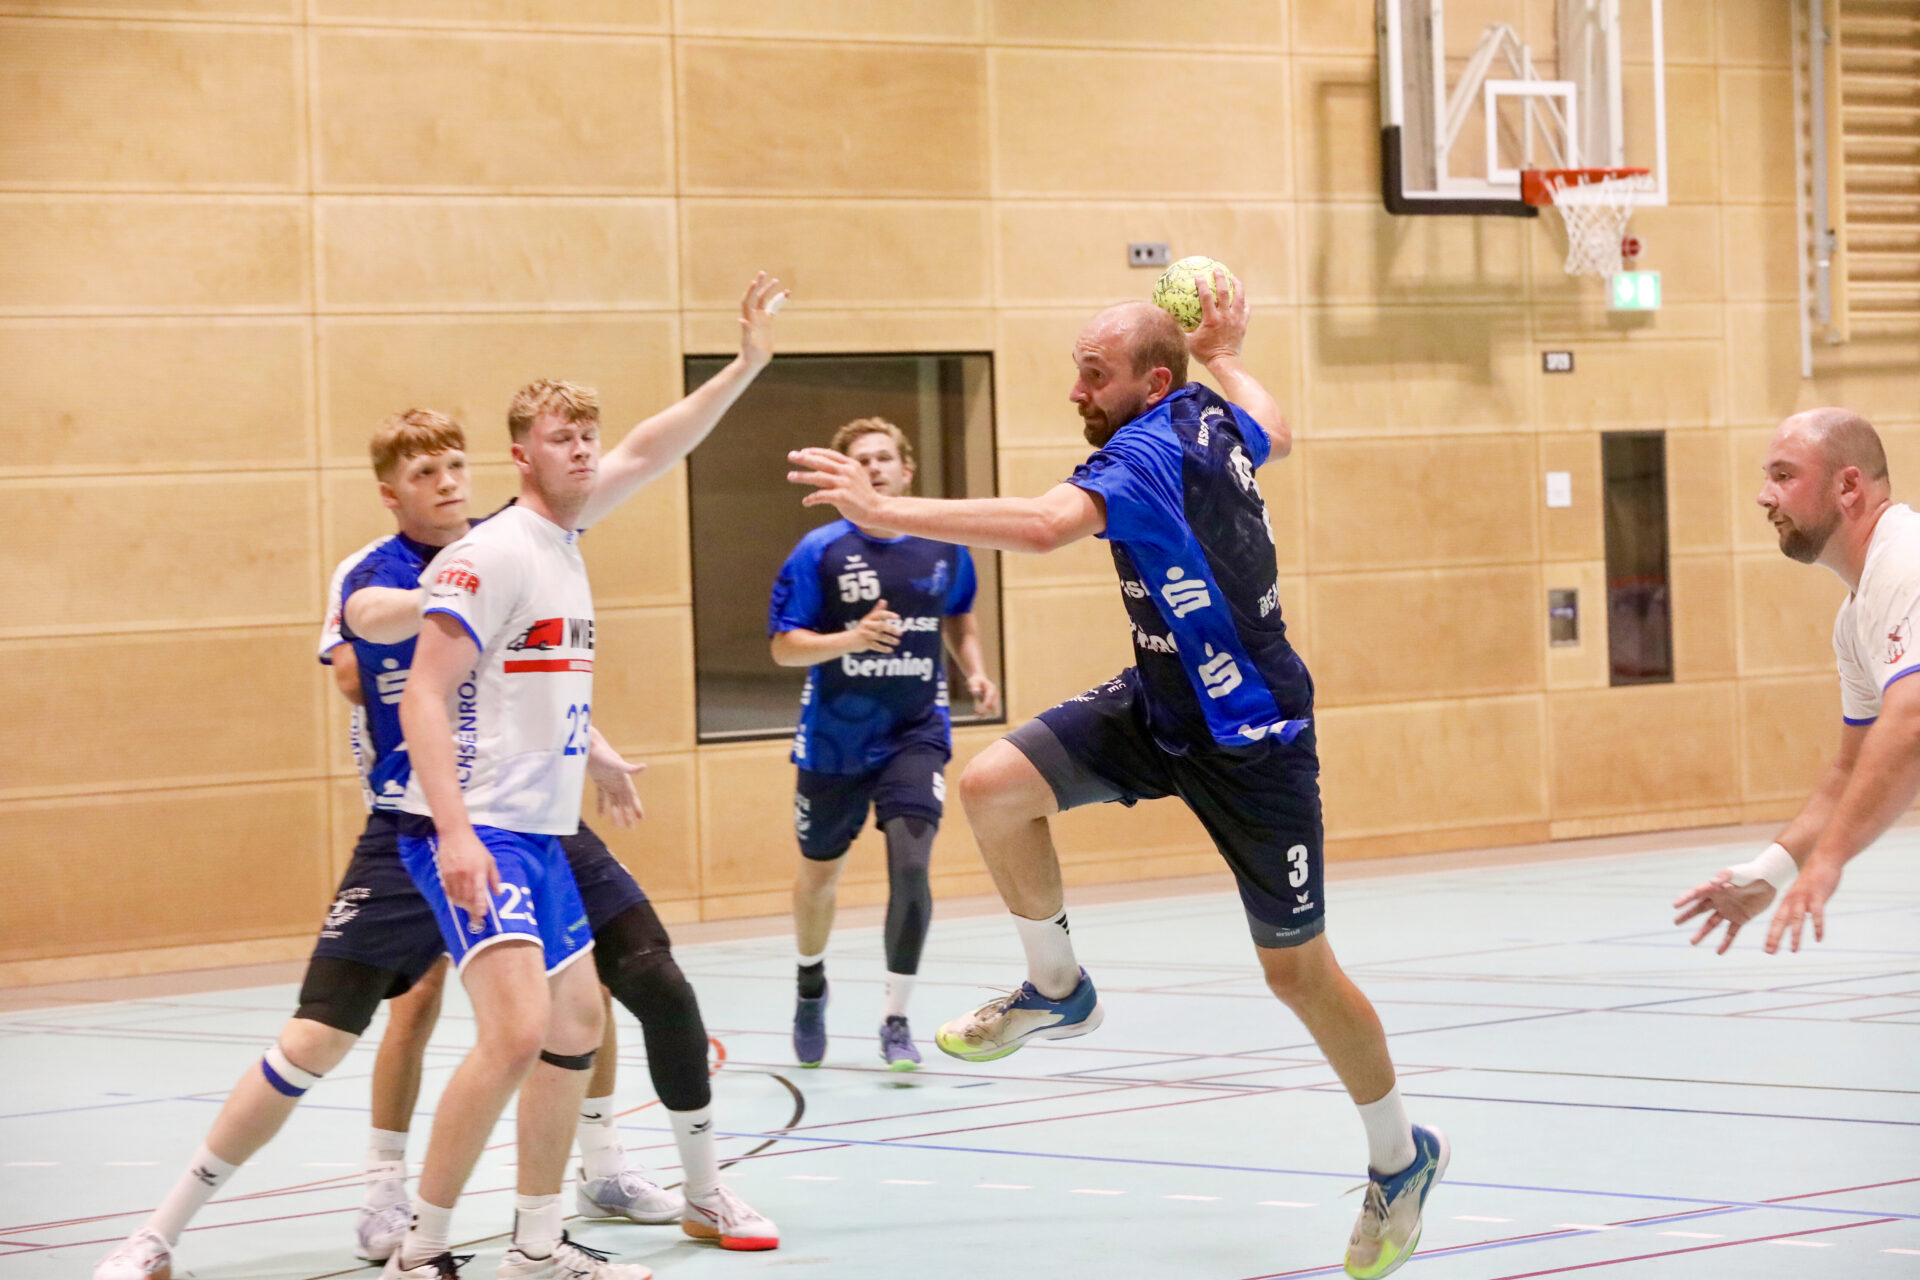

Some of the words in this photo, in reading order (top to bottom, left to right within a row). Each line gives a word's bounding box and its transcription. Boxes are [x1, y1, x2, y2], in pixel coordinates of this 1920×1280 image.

[837, 570, 881, 603] 55
[841, 651, 935, 682] berning
[456, 669, 477, 791] CHSENRO
[563, 704, 592, 757] 23
[1286, 844, 1309, 888] 3
[497, 882, 538, 926] 23
